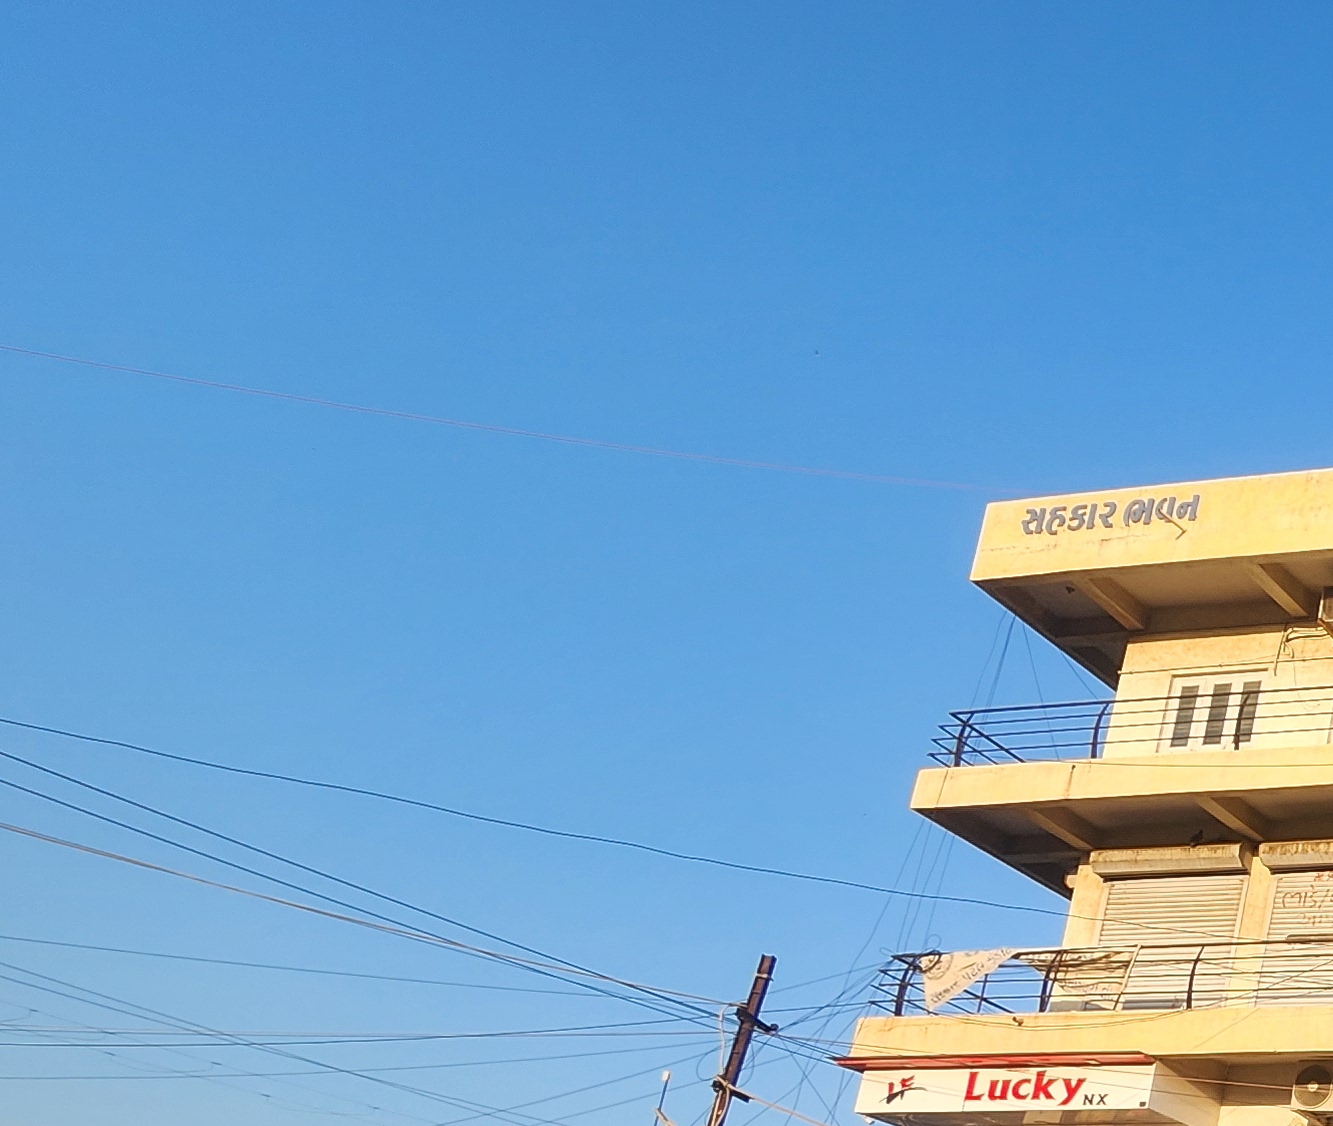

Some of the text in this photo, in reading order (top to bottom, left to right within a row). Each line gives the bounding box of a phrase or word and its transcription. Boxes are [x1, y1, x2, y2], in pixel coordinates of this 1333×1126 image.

[1020, 494, 1200, 536] સહકાર ભવન
[963, 1070, 1109, 1106] Lucky NX
